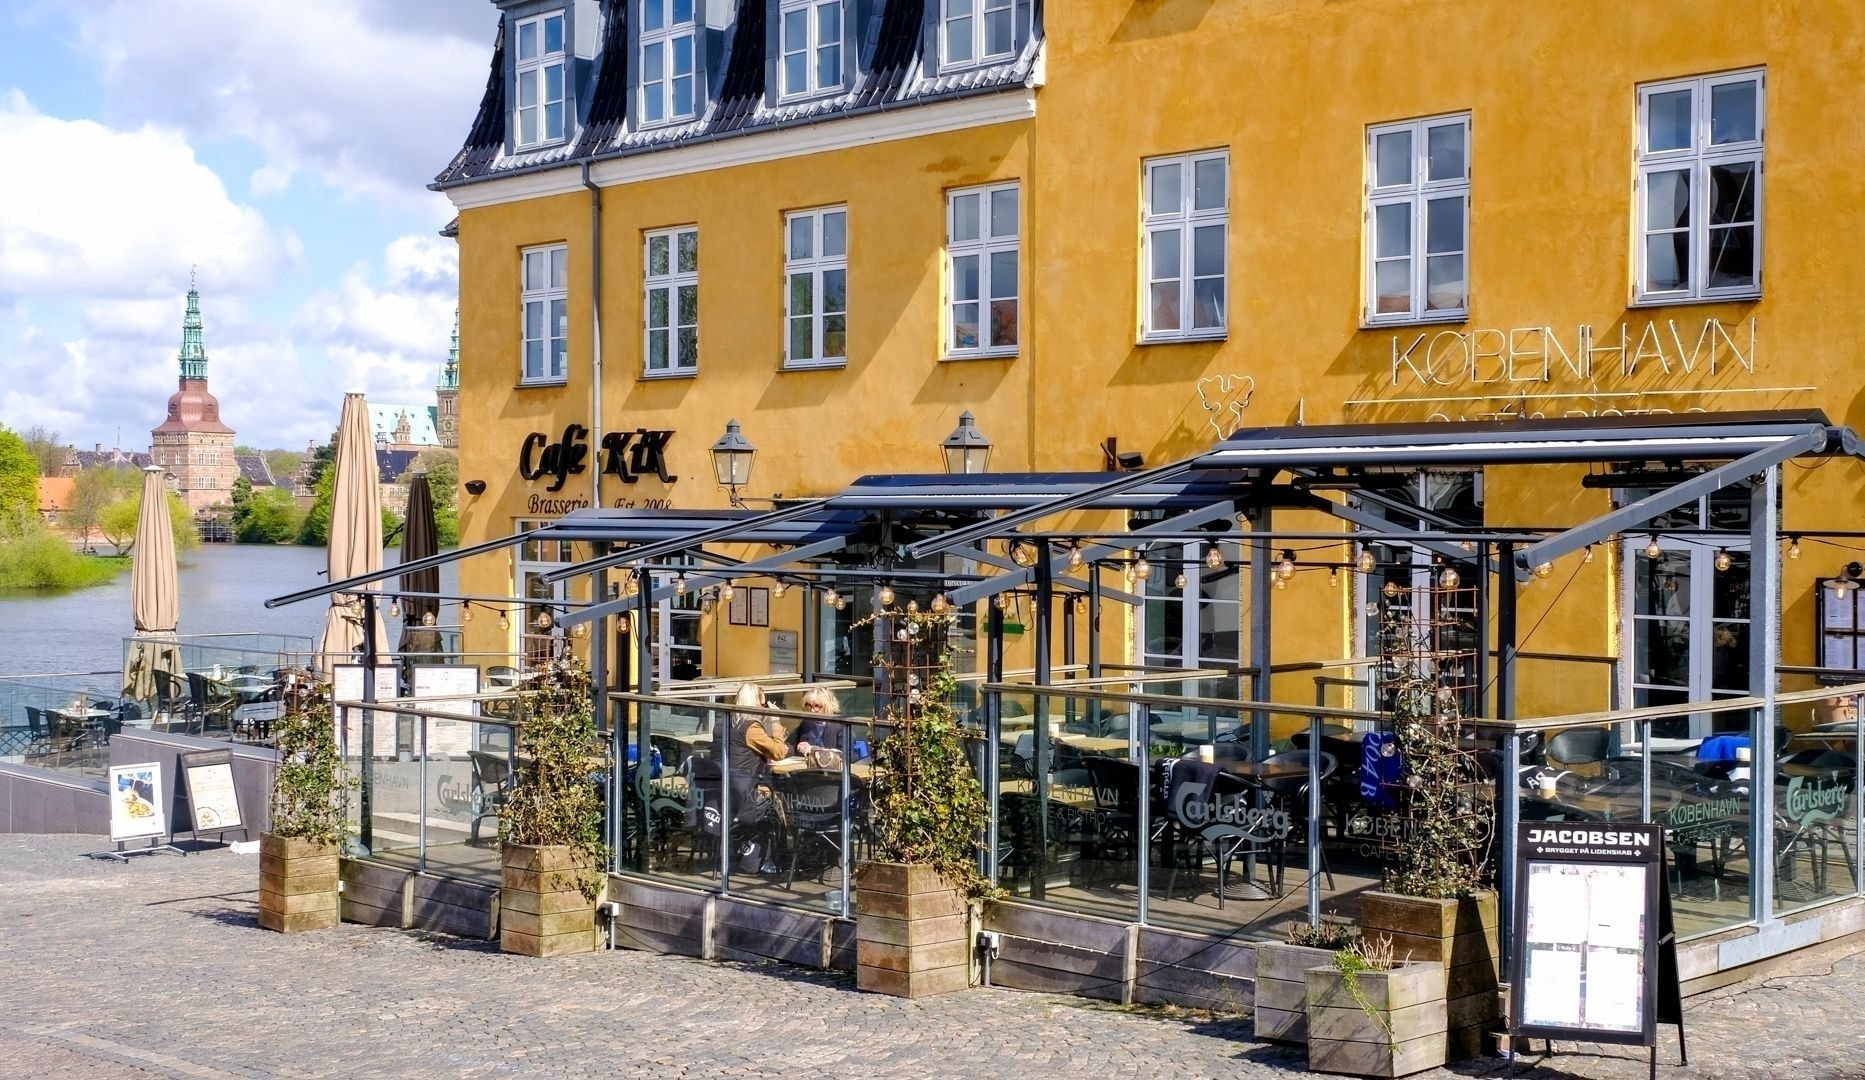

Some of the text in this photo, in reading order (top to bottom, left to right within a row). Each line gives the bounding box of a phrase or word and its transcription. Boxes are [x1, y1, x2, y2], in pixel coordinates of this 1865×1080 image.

[1393, 316, 1757, 386] KØBENHAVN
[520, 424, 589, 491] Café
[528, 494, 588, 514] Brasserie
[1017, 778, 1119, 806] KØENHAVN
[1787, 776, 1846, 821] Carlsberg
[1175, 781, 1290, 840] Carlsberg
[1670, 797, 1741, 826] KØBENHAVN
[1345, 813, 1418, 840] KØBEN
[1528, 829, 1650, 846] JACOBSEN
